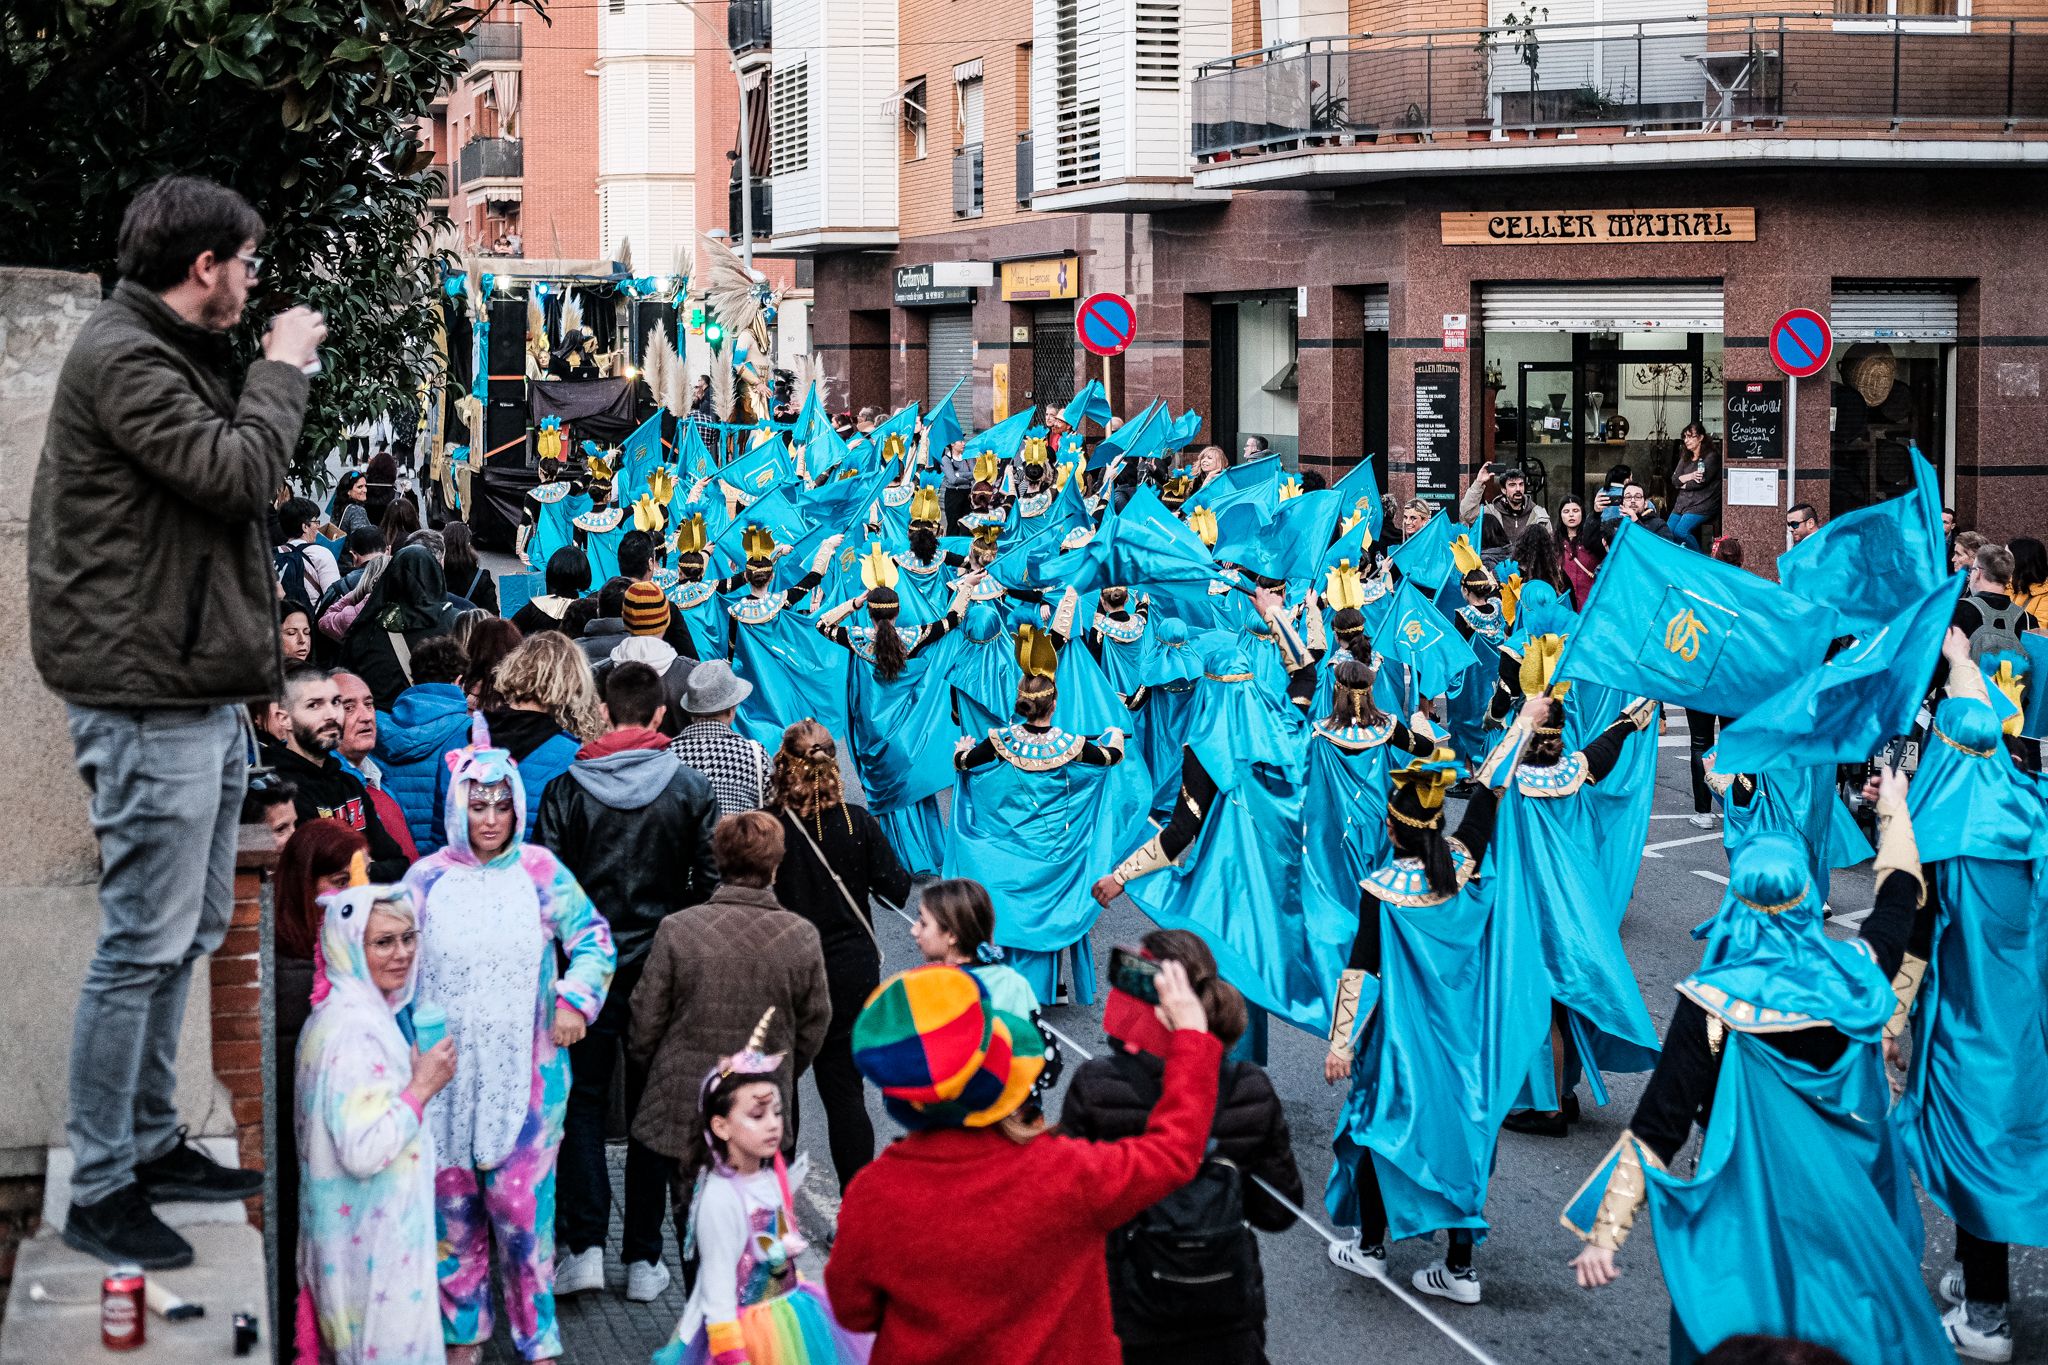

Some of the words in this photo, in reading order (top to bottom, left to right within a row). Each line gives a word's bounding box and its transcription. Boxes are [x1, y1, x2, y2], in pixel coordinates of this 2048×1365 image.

[1488, 215, 1597, 239] CELLER
[898, 268, 929, 291] Cerdanyola
[1886, 740, 1915, 756] 202
[1885, 755, 1907, 767] JZ
